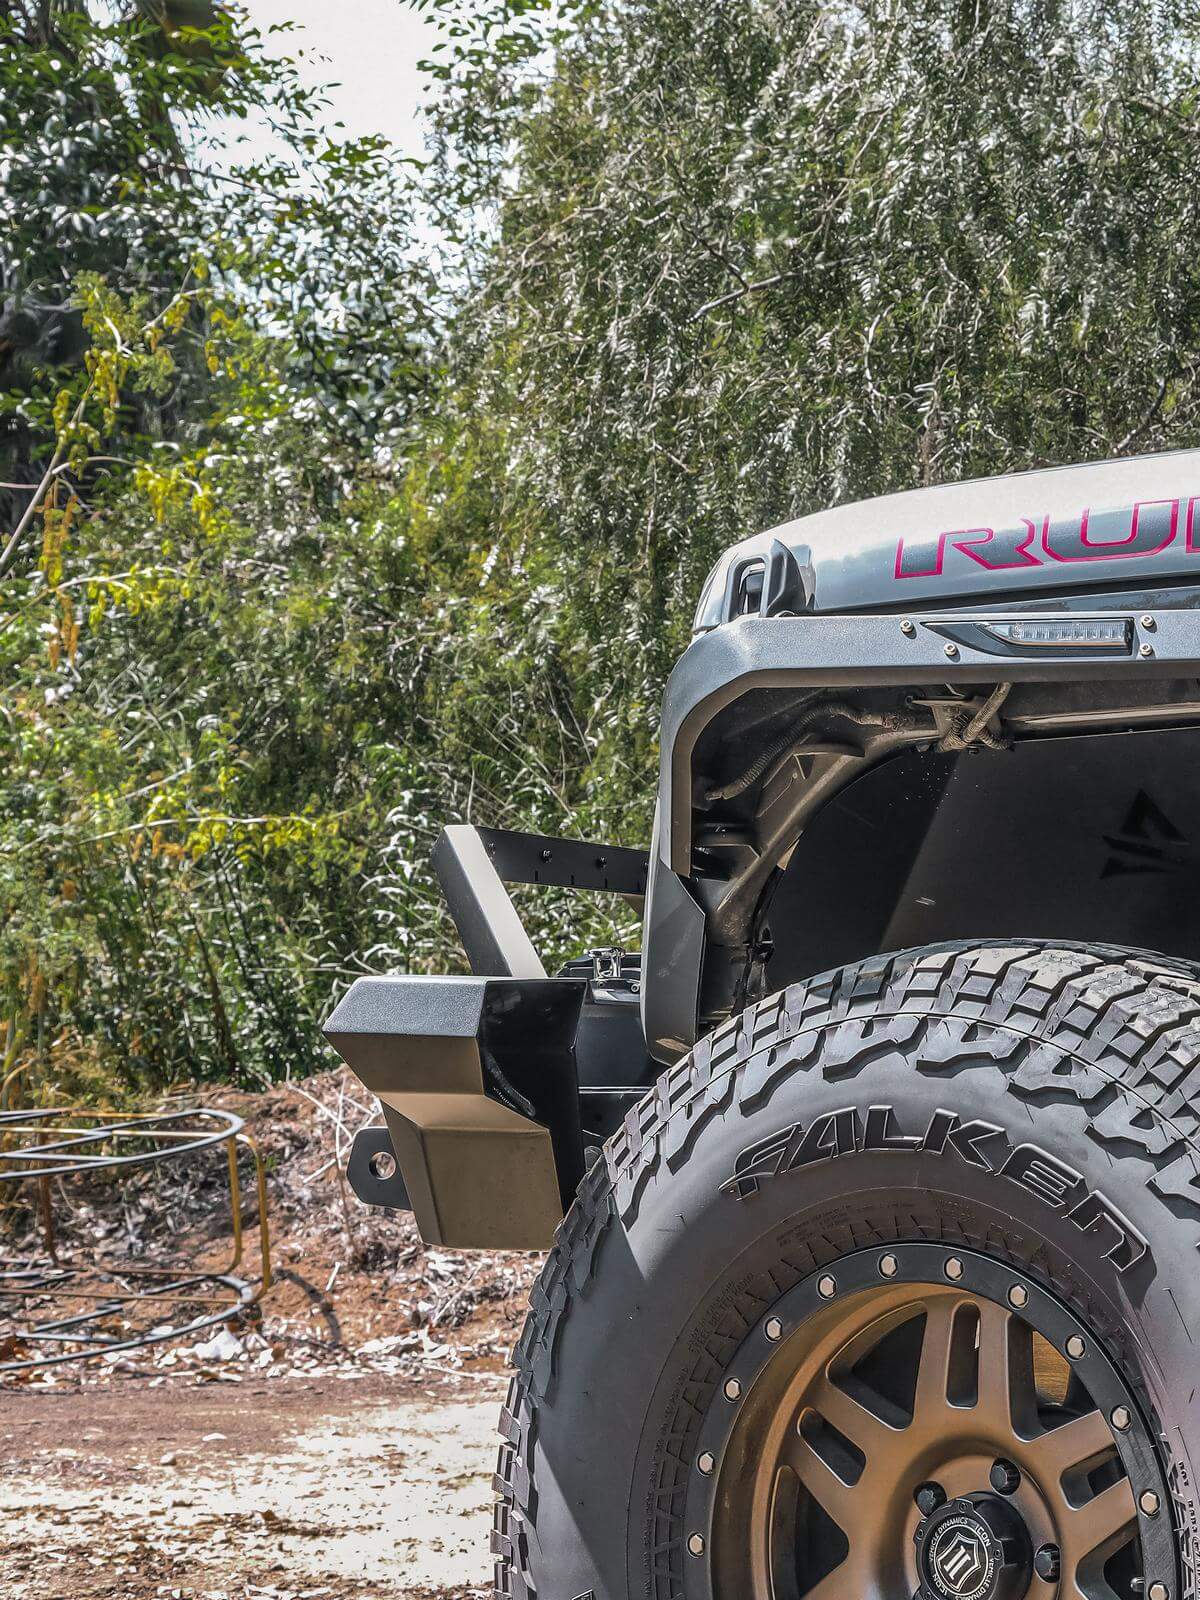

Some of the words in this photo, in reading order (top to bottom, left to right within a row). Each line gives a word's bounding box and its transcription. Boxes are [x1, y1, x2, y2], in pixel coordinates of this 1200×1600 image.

[717, 1105, 1151, 1272] FALKEN
[928, 1531, 940, 1561] VEHICLE
[937, 1516, 968, 1534] DYNAMICS
[974, 1524, 991, 1547] ICON
[932, 1573, 948, 1595] ICON
